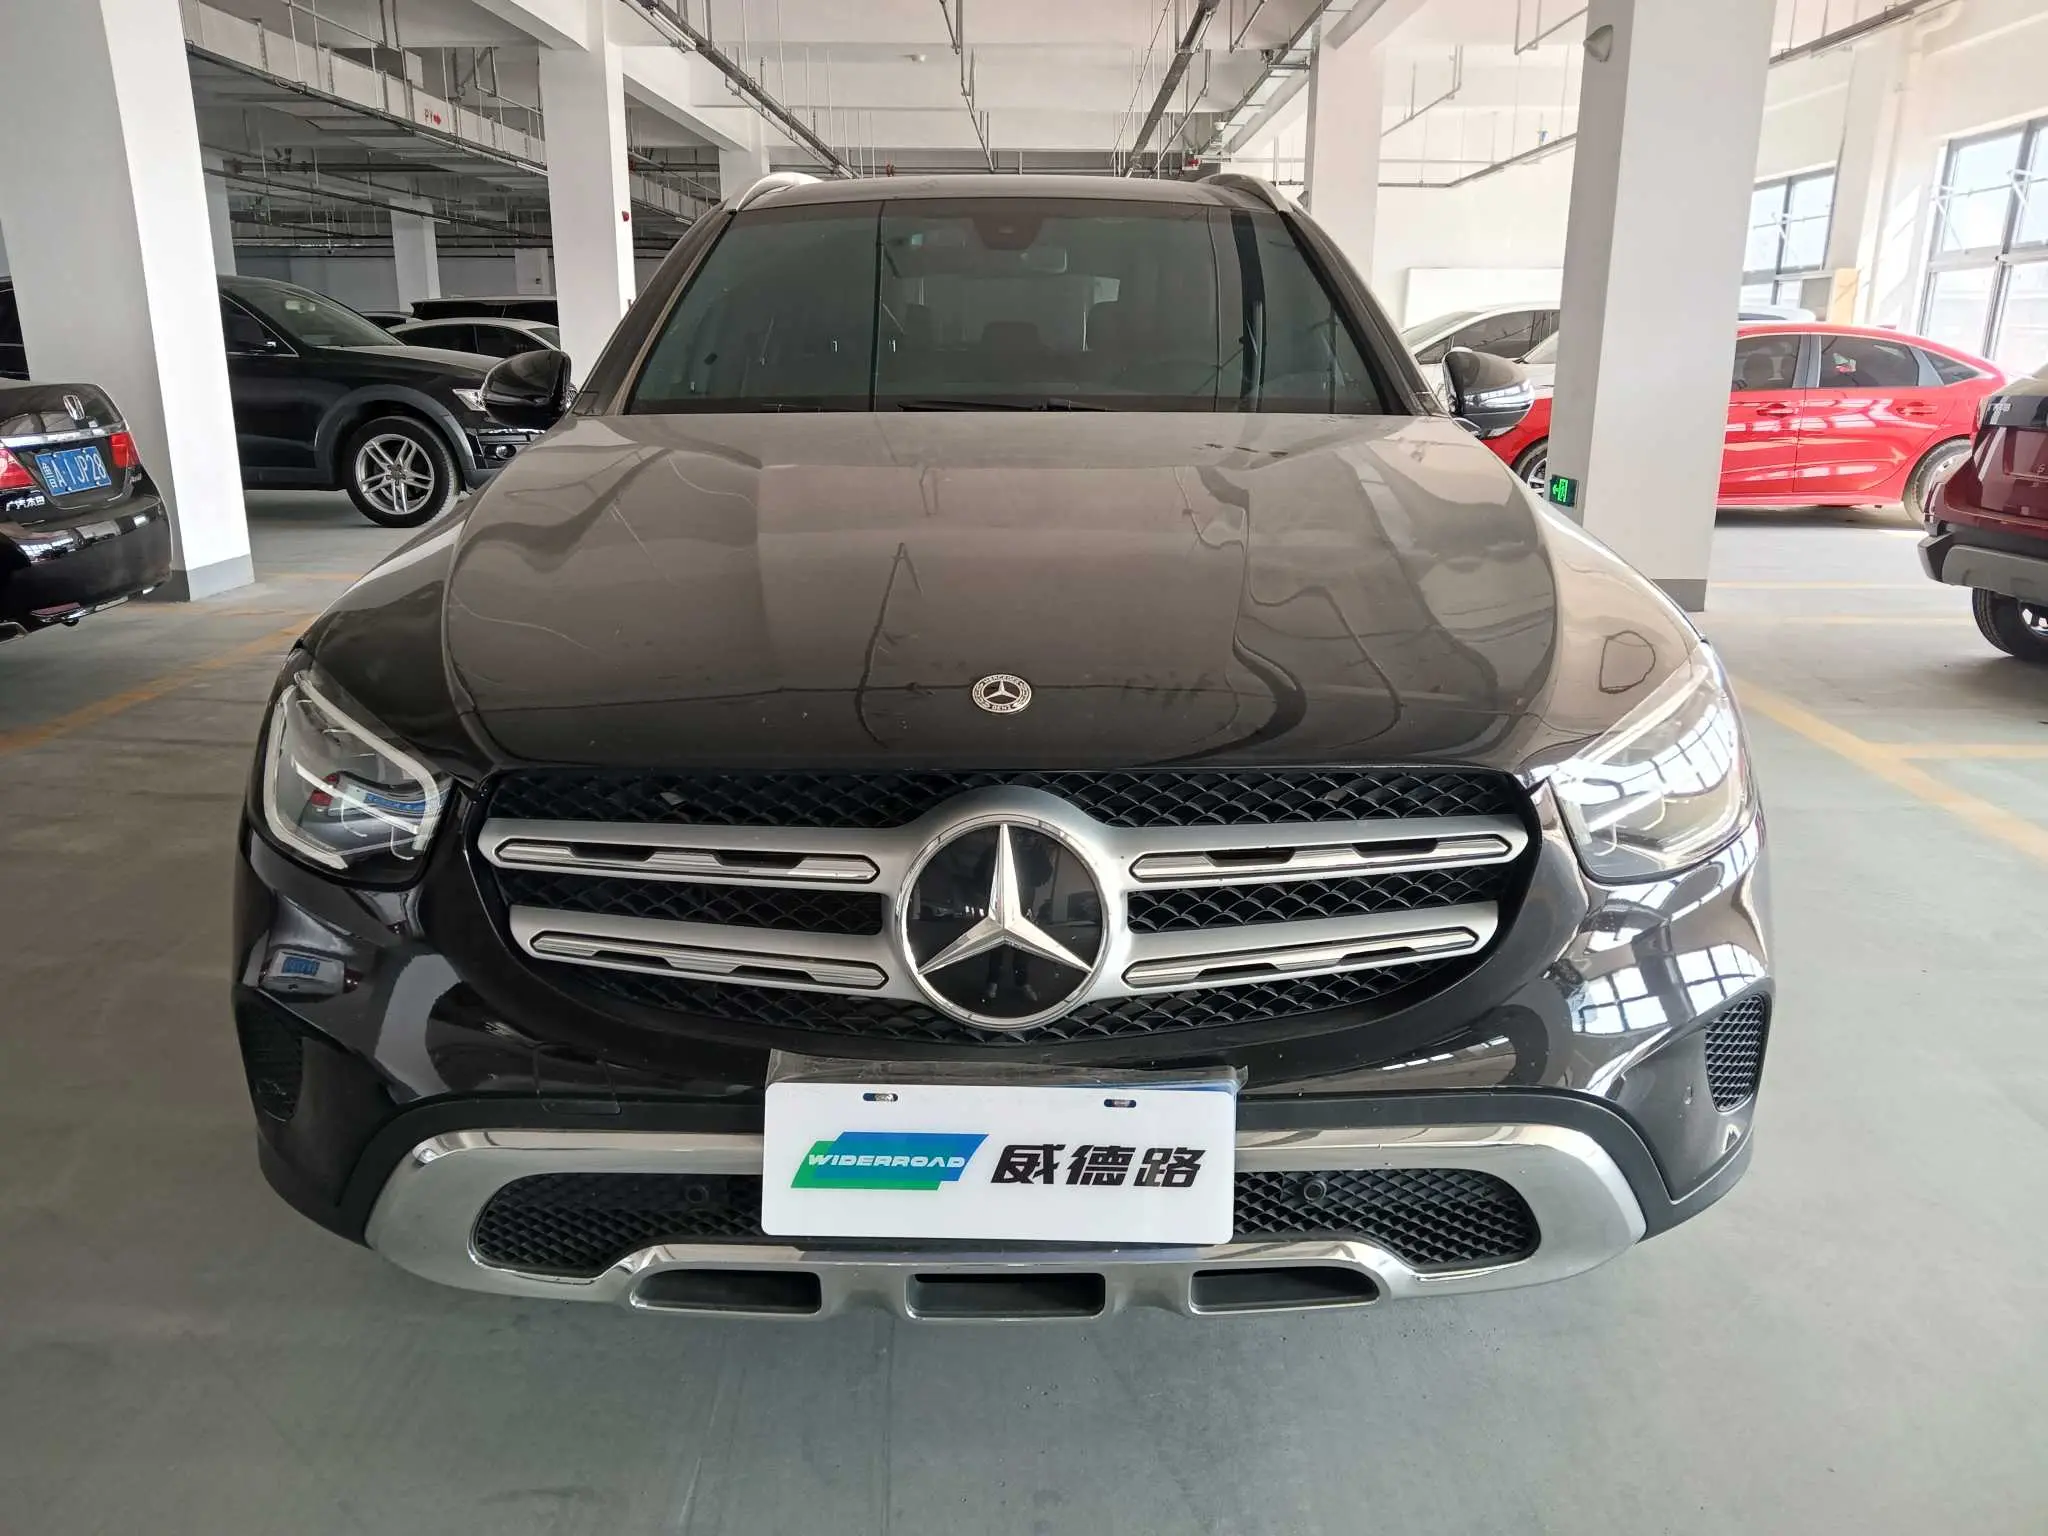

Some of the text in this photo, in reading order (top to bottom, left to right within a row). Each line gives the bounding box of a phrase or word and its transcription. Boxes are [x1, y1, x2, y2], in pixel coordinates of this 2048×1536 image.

[807, 1153, 967, 1169] WIDERROAD
[990, 1143, 1207, 1188] 威德路
